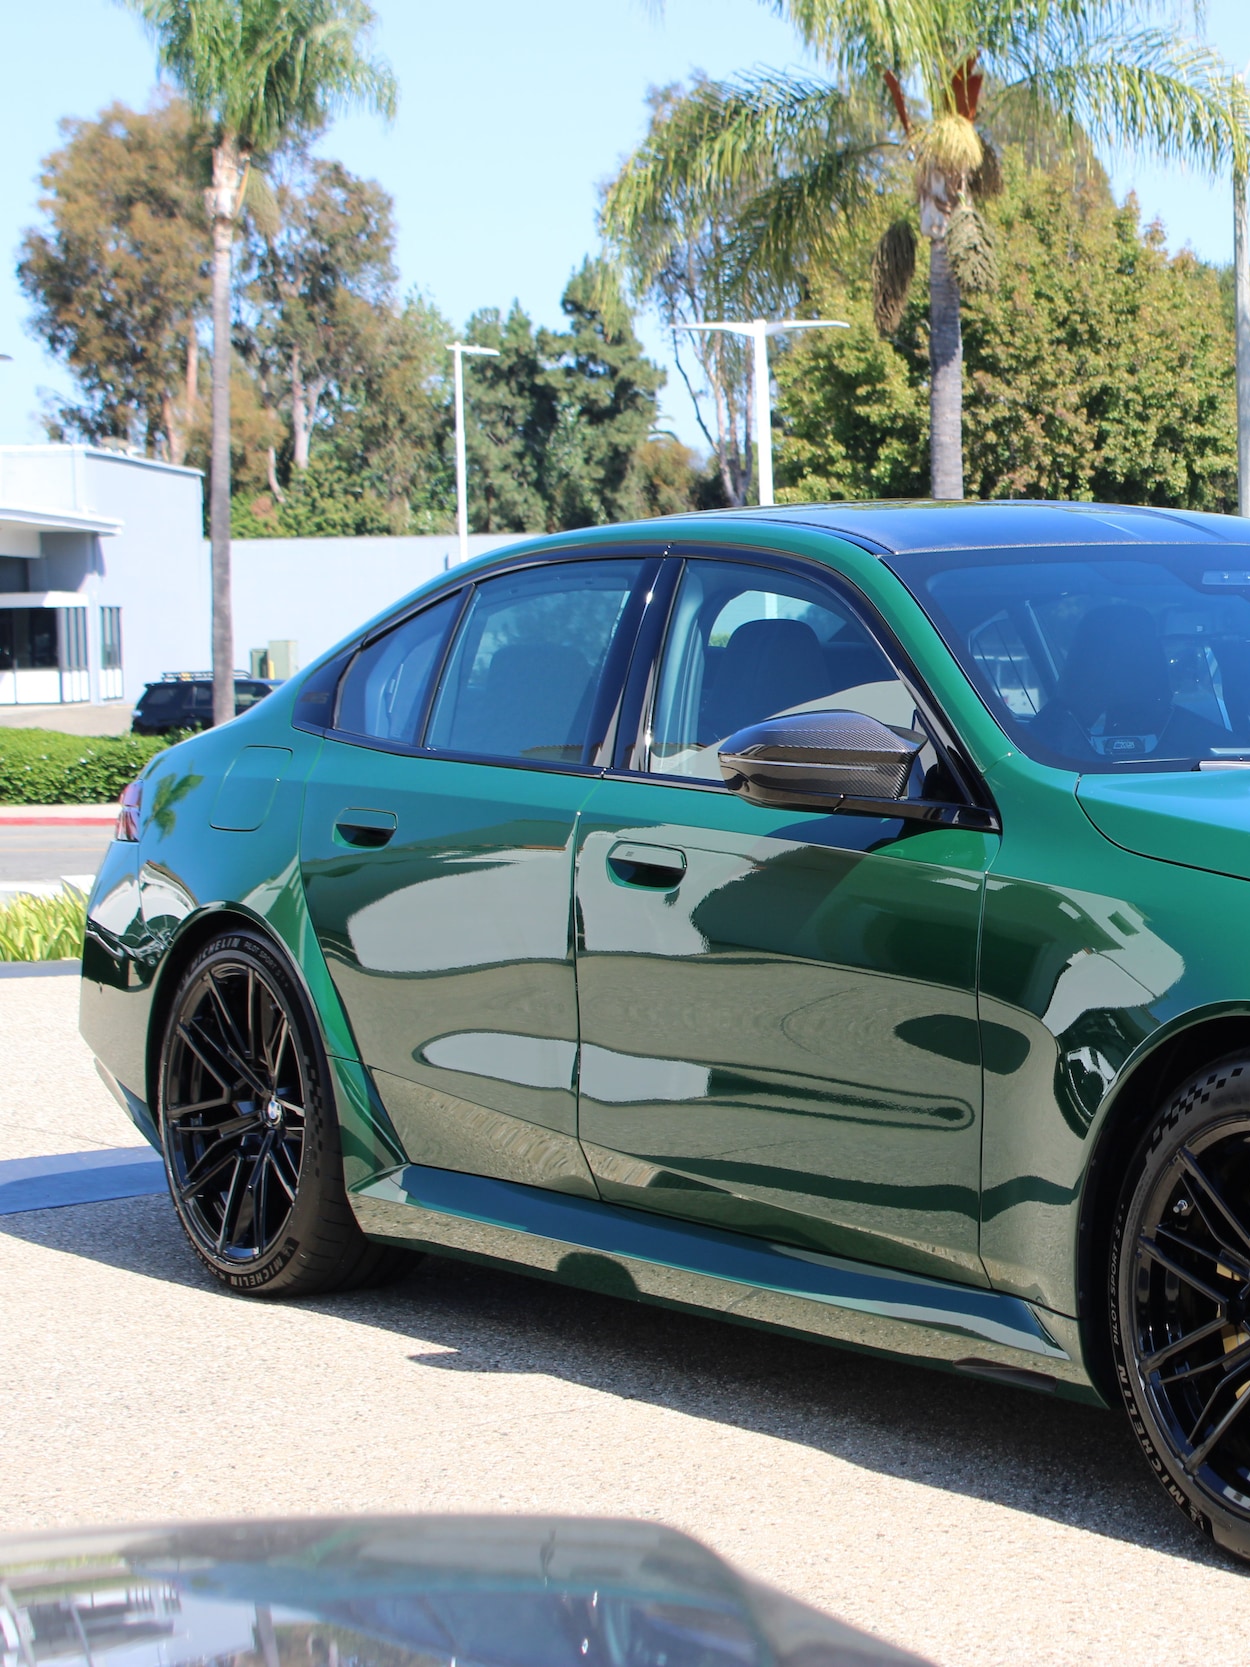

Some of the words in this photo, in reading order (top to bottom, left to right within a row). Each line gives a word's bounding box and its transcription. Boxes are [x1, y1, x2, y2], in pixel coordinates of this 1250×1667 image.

[229, 1255, 285, 1287] MICHELIN
[1110, 1242, 1121, 1296] SPORT
[1110, 1299, 1120, 1345] PILOT
[1117, 1364, 1186, 1505] MICHELIN
